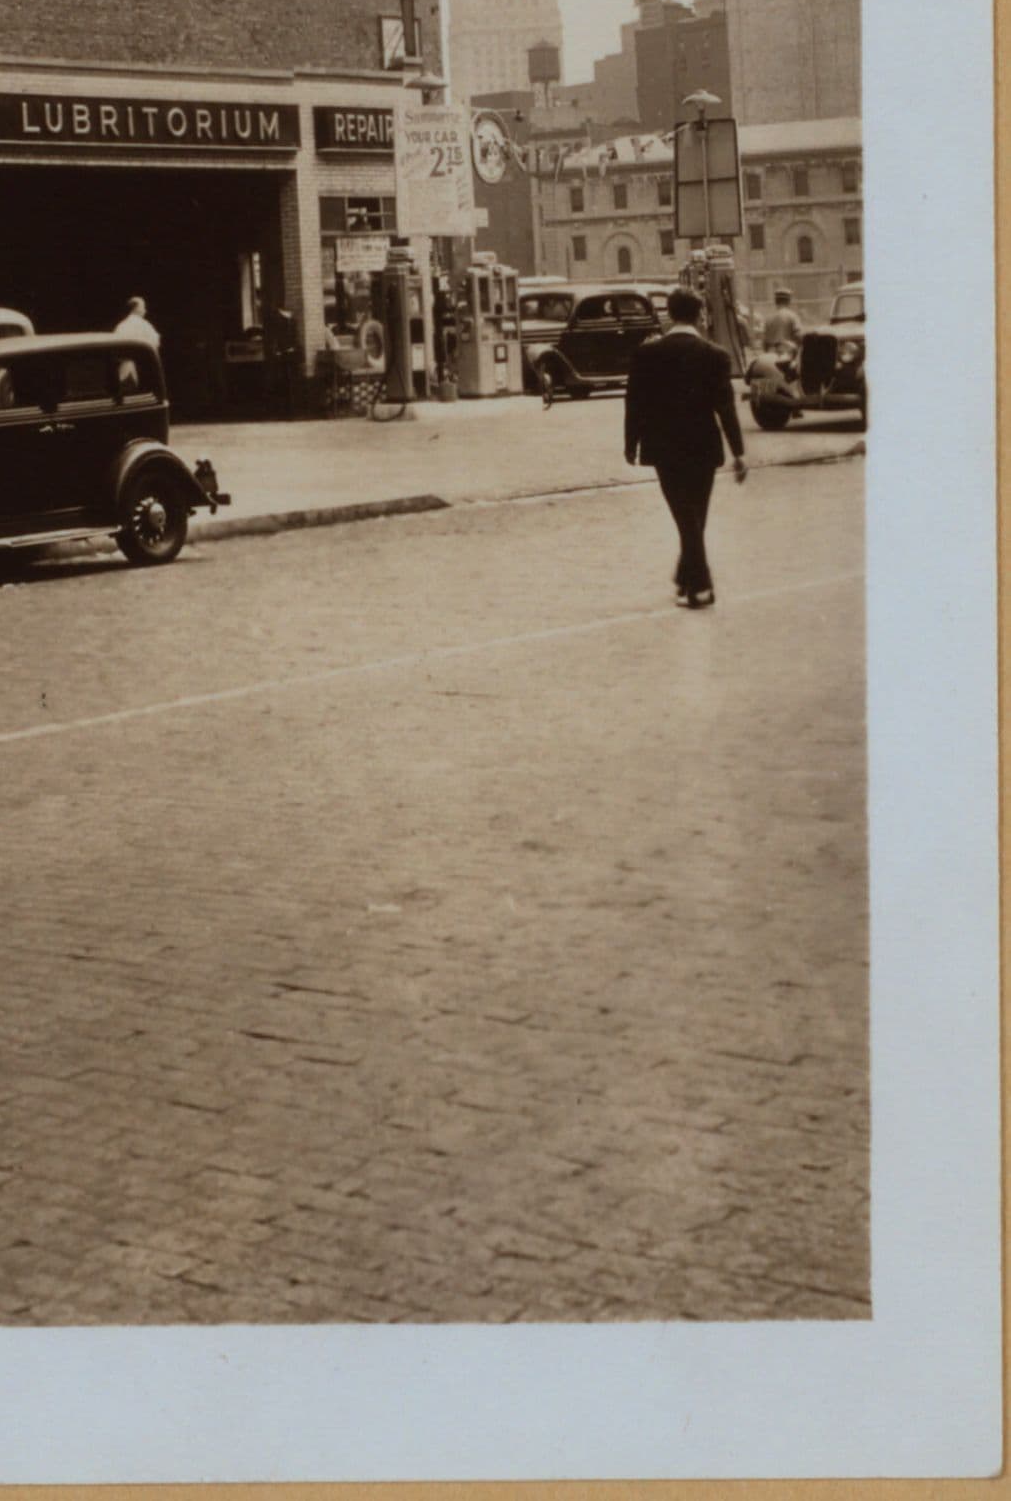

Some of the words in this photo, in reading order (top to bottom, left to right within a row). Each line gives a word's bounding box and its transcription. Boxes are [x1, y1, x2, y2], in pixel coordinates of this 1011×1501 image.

[21, 101, 281, 140] LUBRITORIUM
[404, 130, 431, 144] YOUR
[434, 130, 458, 144] CAR
